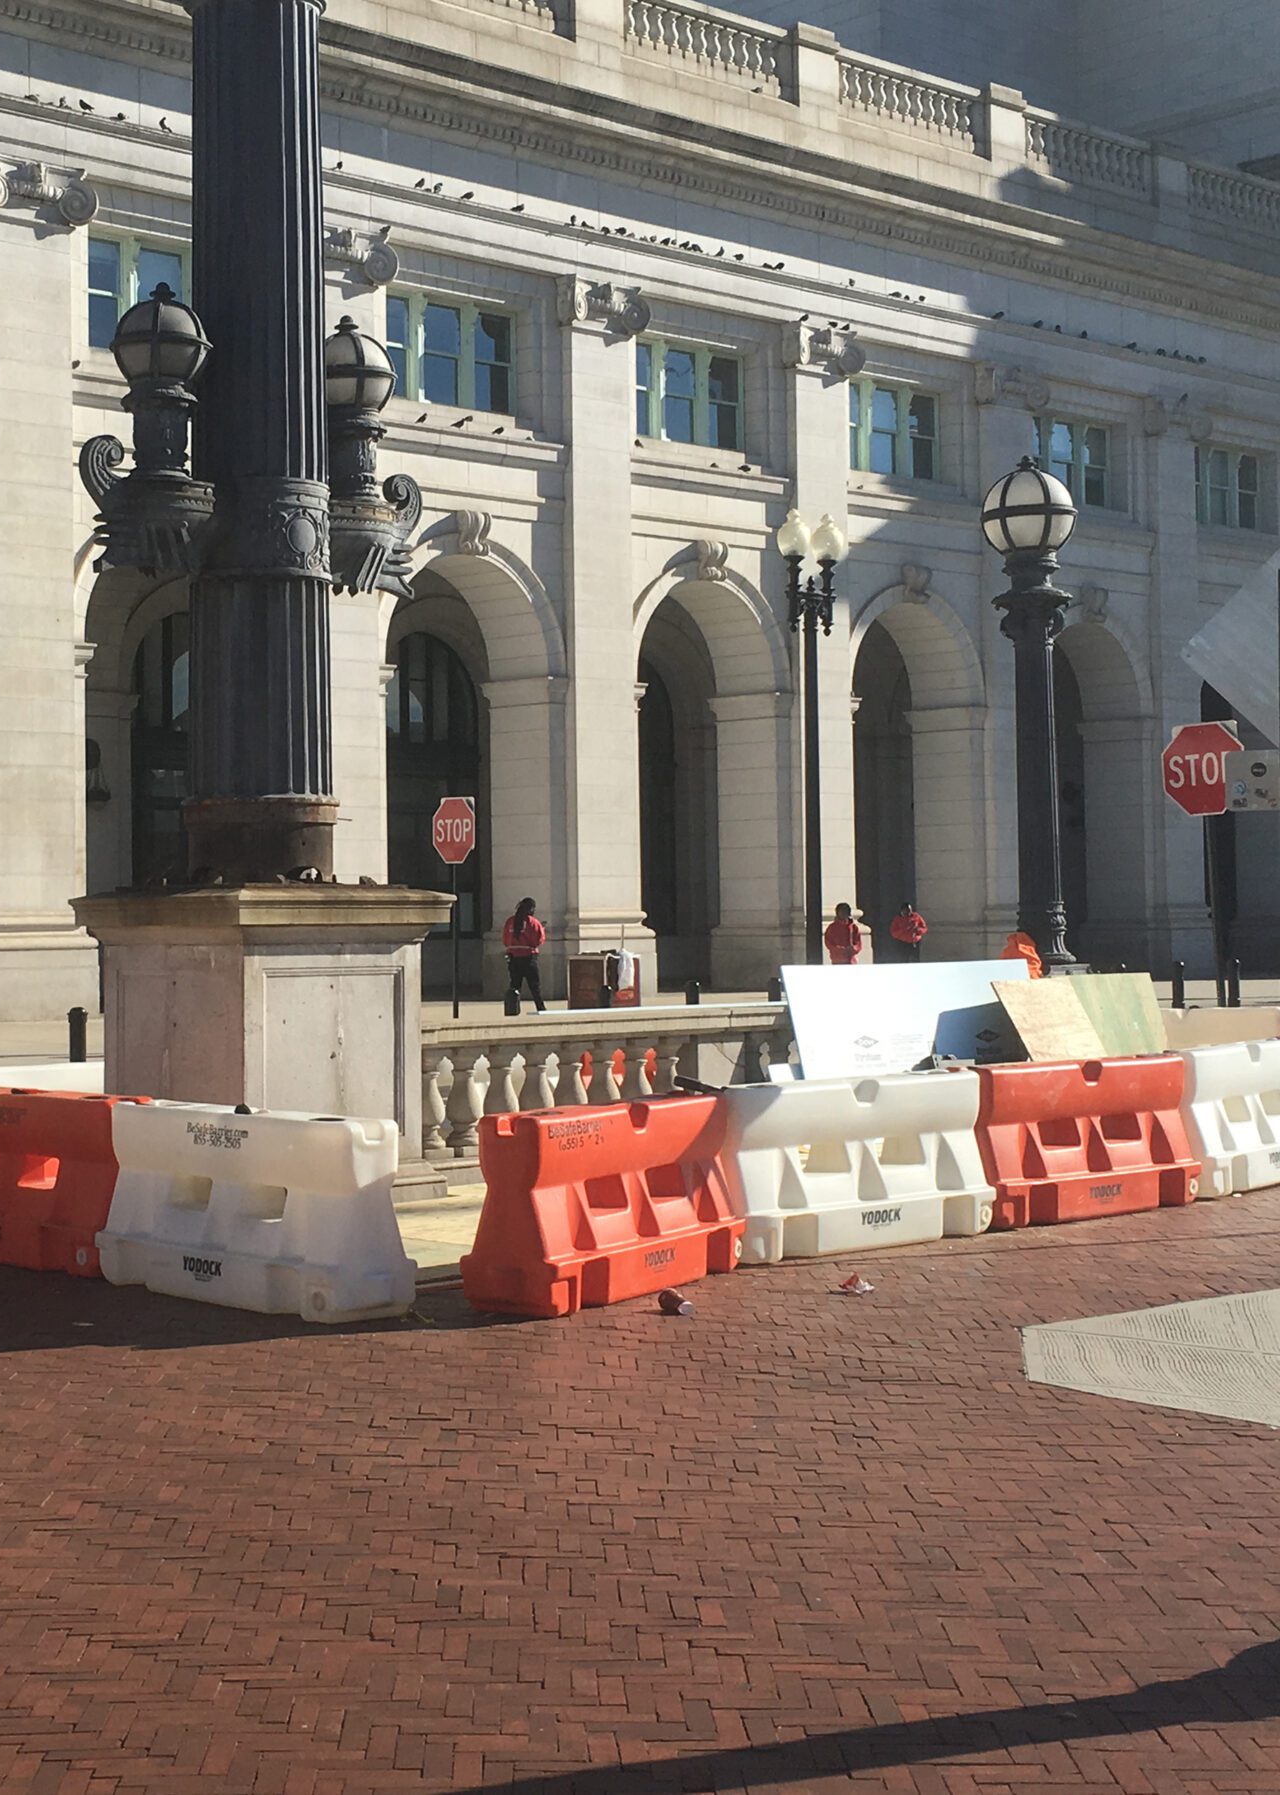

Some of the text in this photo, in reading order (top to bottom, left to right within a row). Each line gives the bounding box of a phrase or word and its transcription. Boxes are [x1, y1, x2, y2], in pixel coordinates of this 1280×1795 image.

[1168, 751, 1226, 789] STO
[436, 818, 472, 842] STOP
[861, 1207, 901, 1225] YODOCK
[183, 1255, 222, 1277] YODOCK
[644, 1247, 676, 1268] YODOCK
